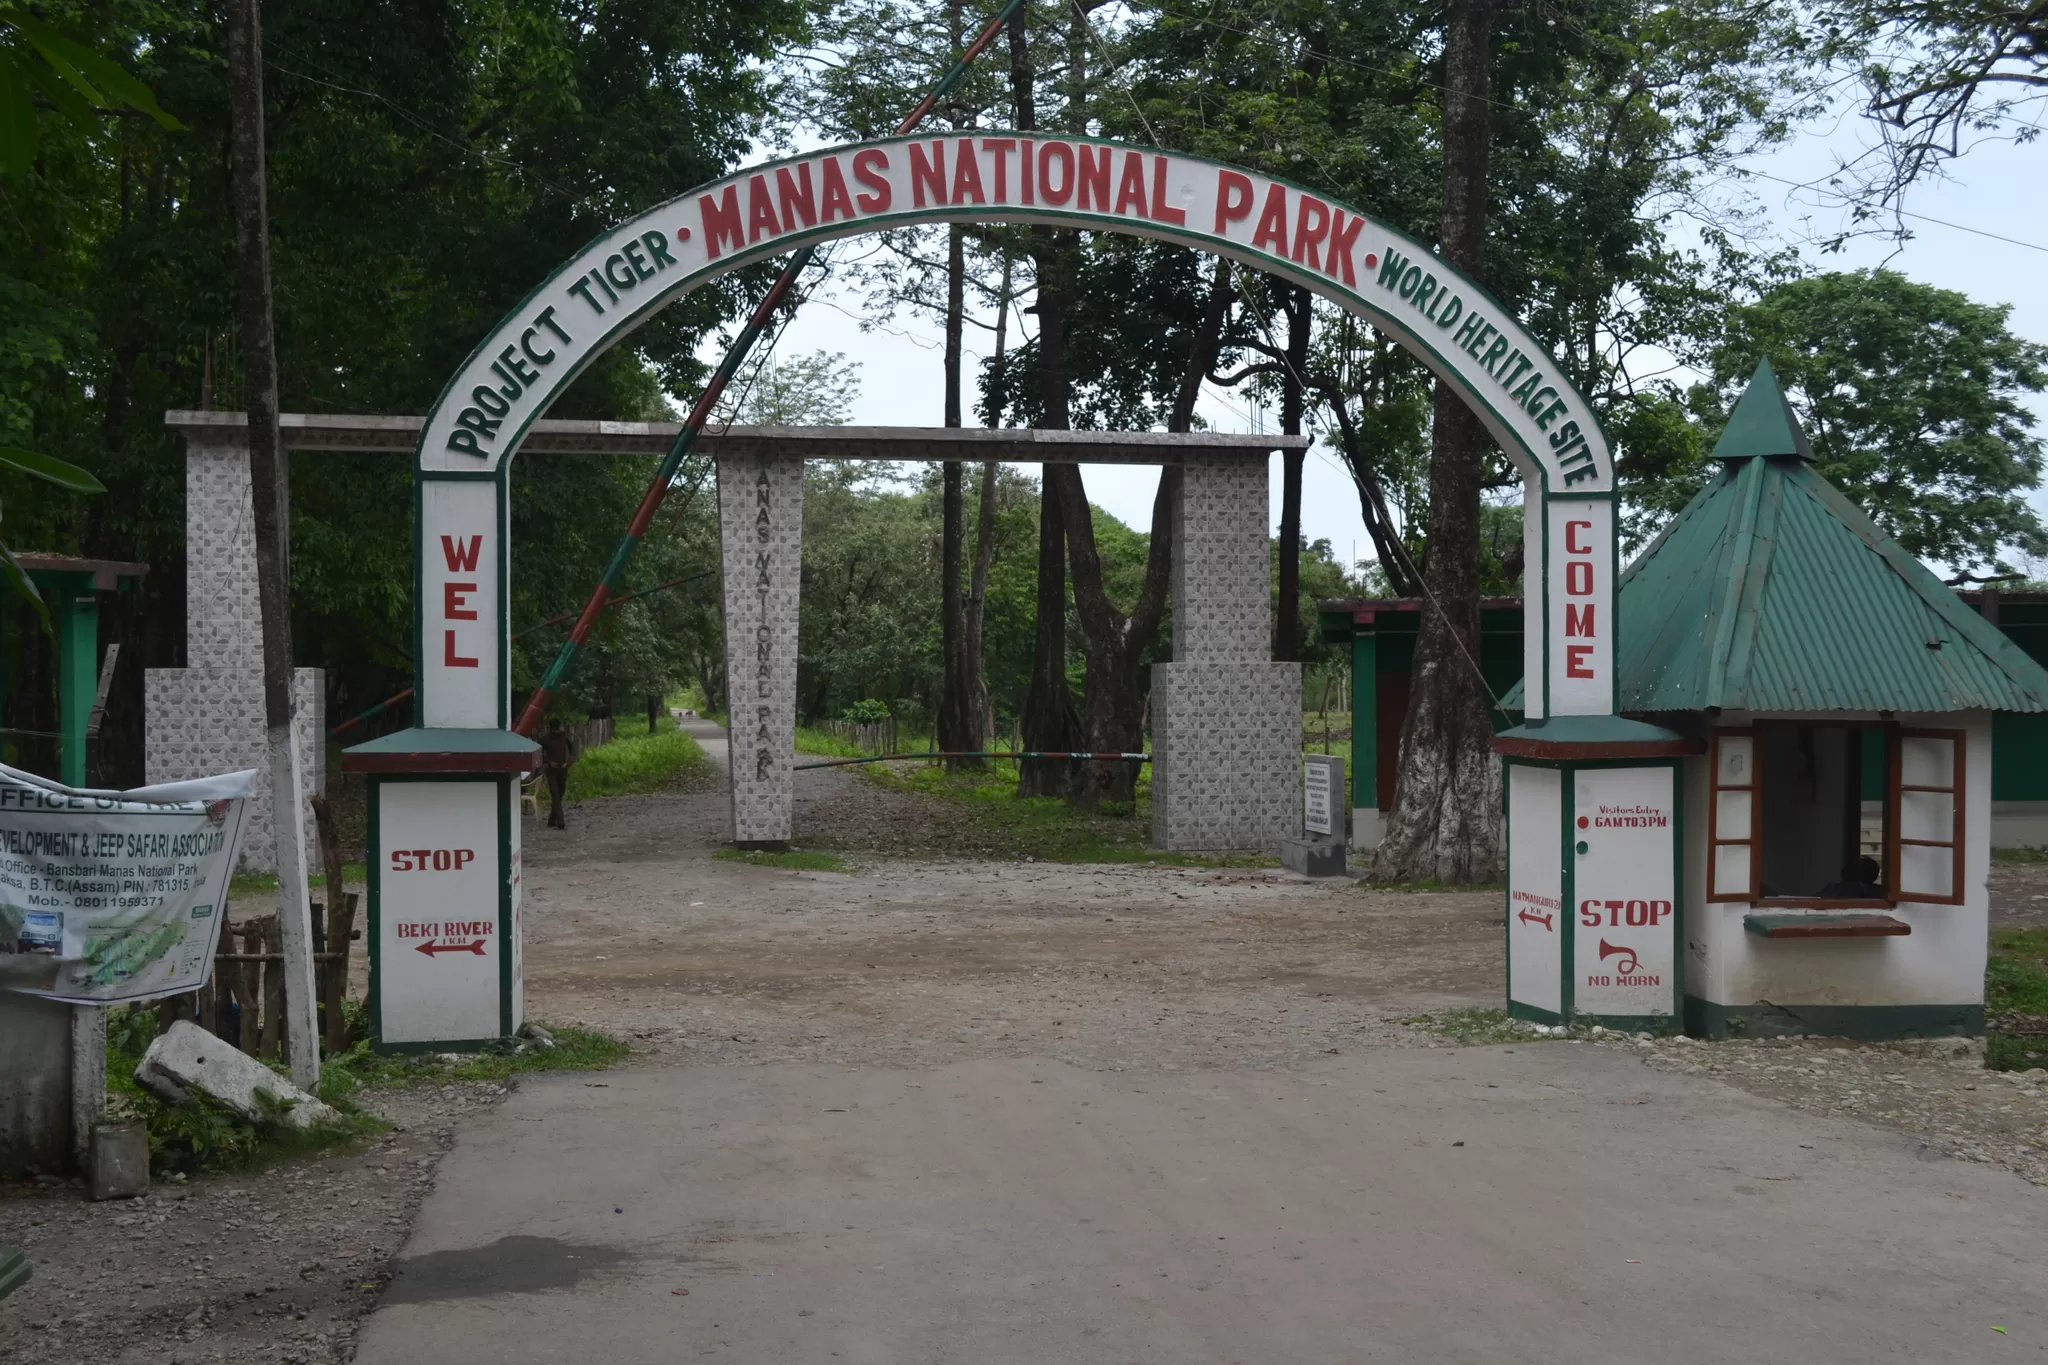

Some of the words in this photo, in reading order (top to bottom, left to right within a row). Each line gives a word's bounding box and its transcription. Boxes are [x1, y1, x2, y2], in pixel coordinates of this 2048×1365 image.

[446, 305, 574, 460] PROJECT
[566, 230, 678, 315] TIGER
[698, 148, 892, 260] MANAS
[908, 137, 1186, 225] NATIONAL
[1214, 167, 1366, 289] PARK
[1376, 246, 1464, 330] WORLD
[1451, 311, 1569, 431] HERITAGE
[1549, 419, 1598, 487] SITE
[440, 534, 484, 668] WEL
[1565, 520, 1596, 679] COME
[1599, 805, 1634, 815] Visitors
[1635, 805, 1660, 816] Entry
[81, 833, 90, 857] &
[93, 833, 124, 857] JEEP
[127, 833, 169, 858] SAFARI
[5, 860, 37, 875] Office
[46, 863, 97, 877] Bansbari
[100, 864, 134, 877] Manas
[138, 864, 175, 877] National
[178, 863, 198, 876] Park
[391, 849, 475, 871] STOP
[1580, 900, 1672, 927] STOP
[397, 923, 439, 938] BEKI
[444, 921, 493, 937] RIVER
[1588, 976, 1610, 987] NO
[1616, 975, 1660, 987] HORN
